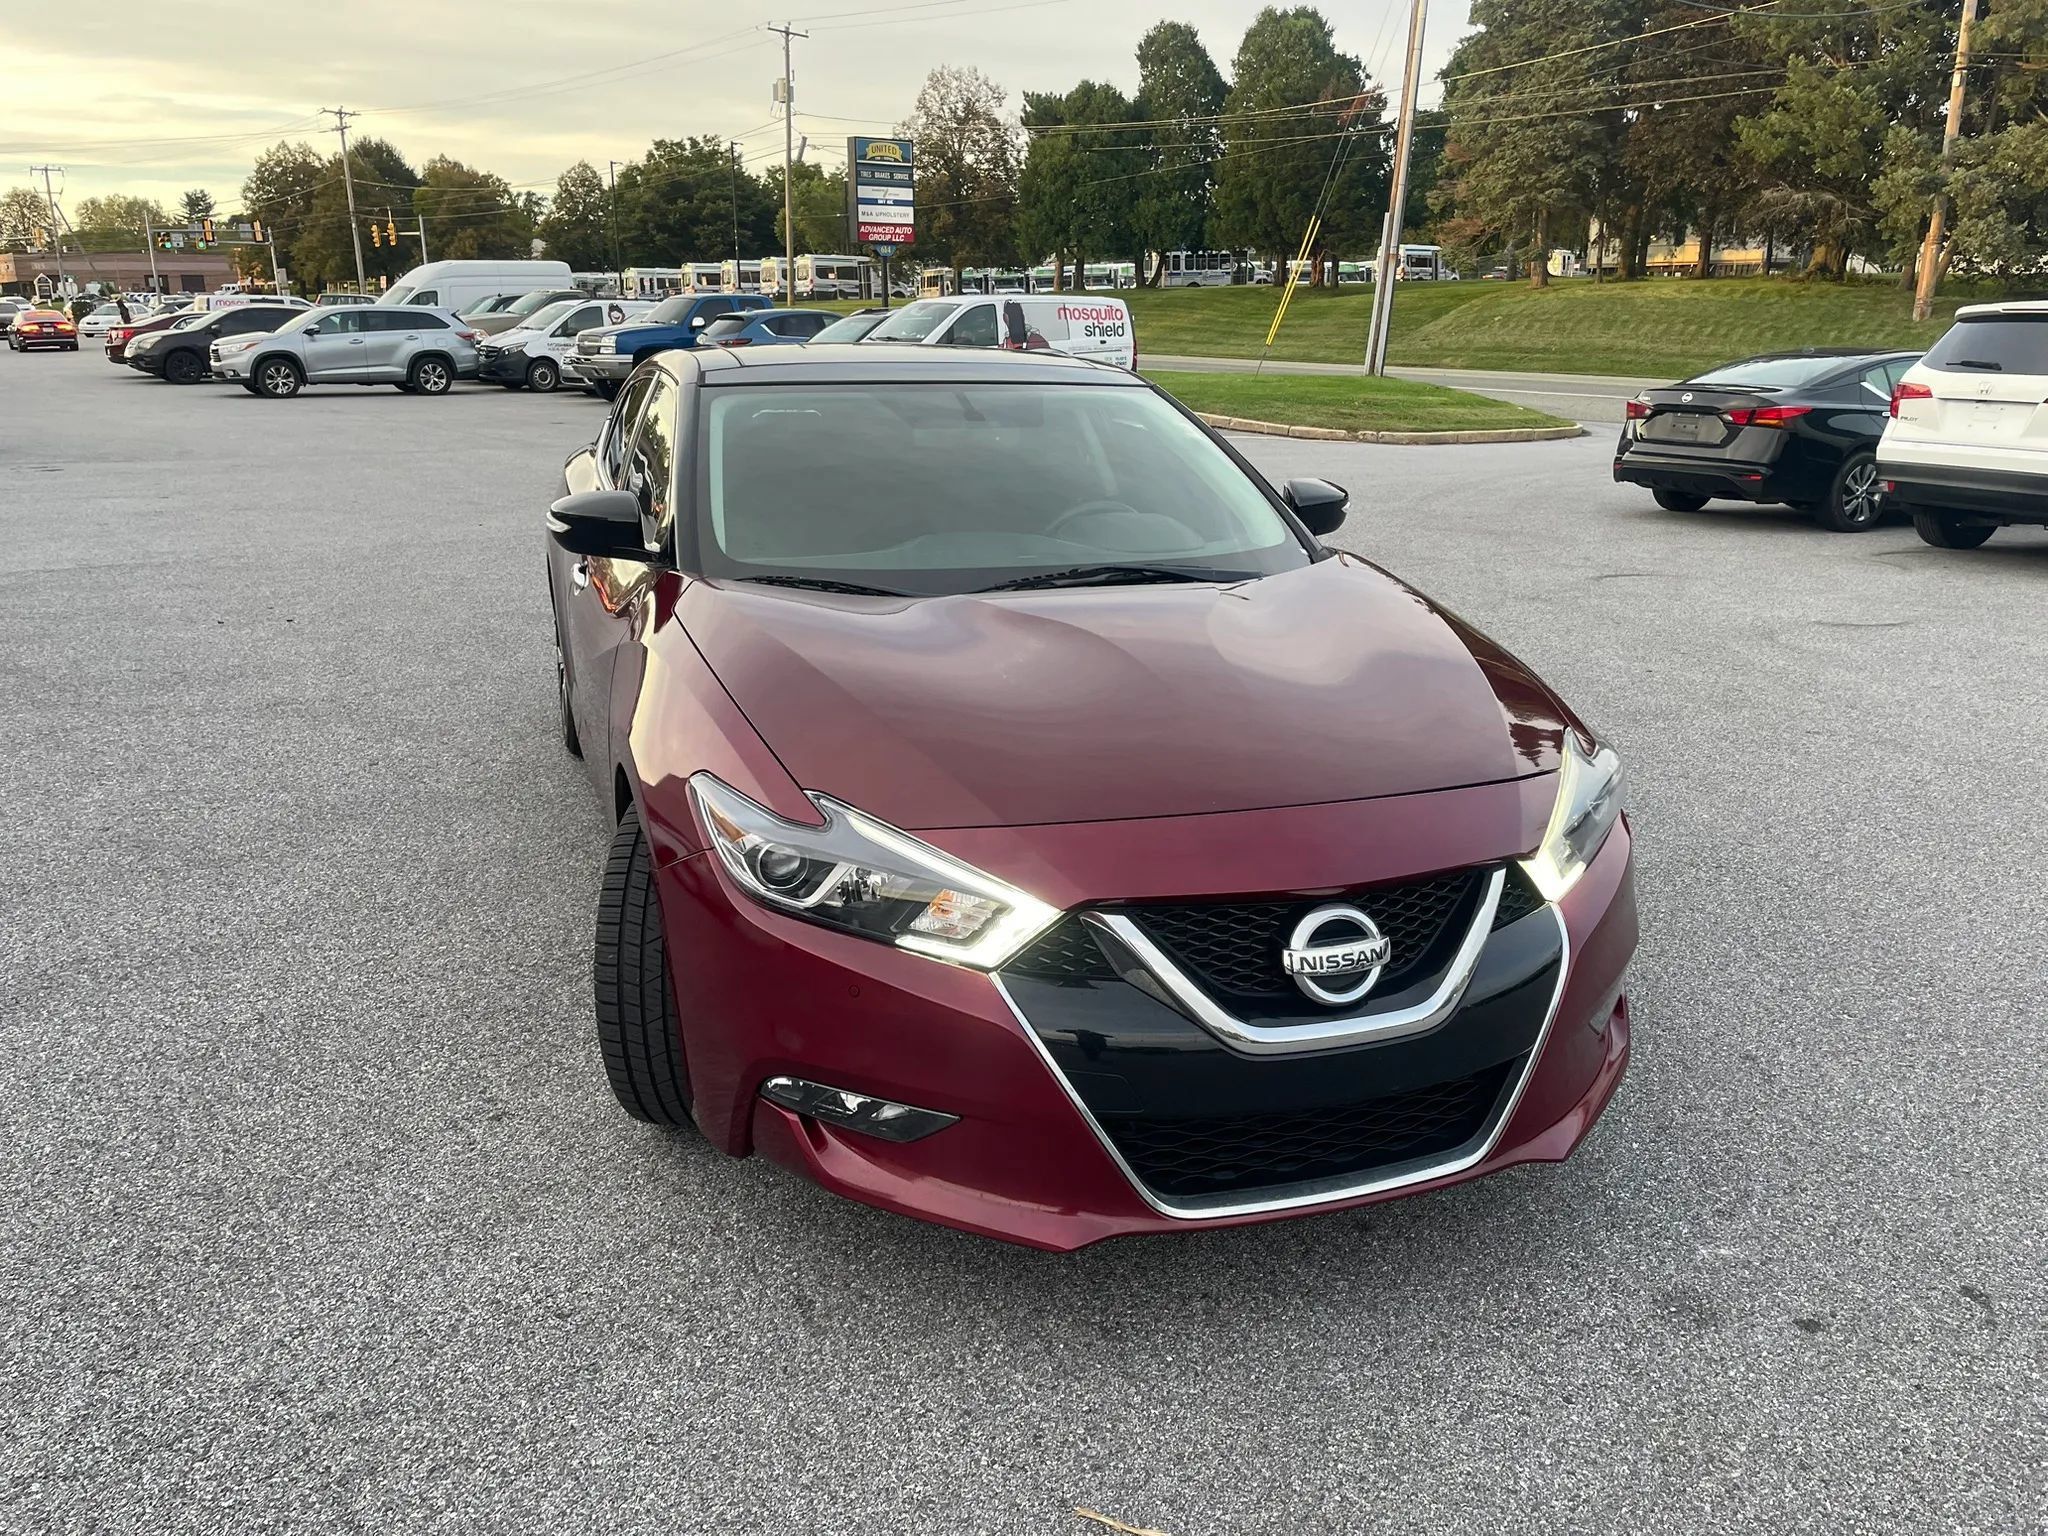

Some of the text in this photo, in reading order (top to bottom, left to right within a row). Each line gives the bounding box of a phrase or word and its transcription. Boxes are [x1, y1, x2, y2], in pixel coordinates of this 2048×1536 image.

[871, 144, 897, 155] UNITED
[874, 171, 890, 179] BRAKES
[893, 171, 909, 180] SERVICE
[860, 225, 912, 234] ADVANCED AUTO
[868, 233, 905, 242] GROUP LLC
[1057, 305, 1124, 325] mosquito
[1084, 322, 1125, 337] shield
[1299, 946, 1384, 971] NISSAN
